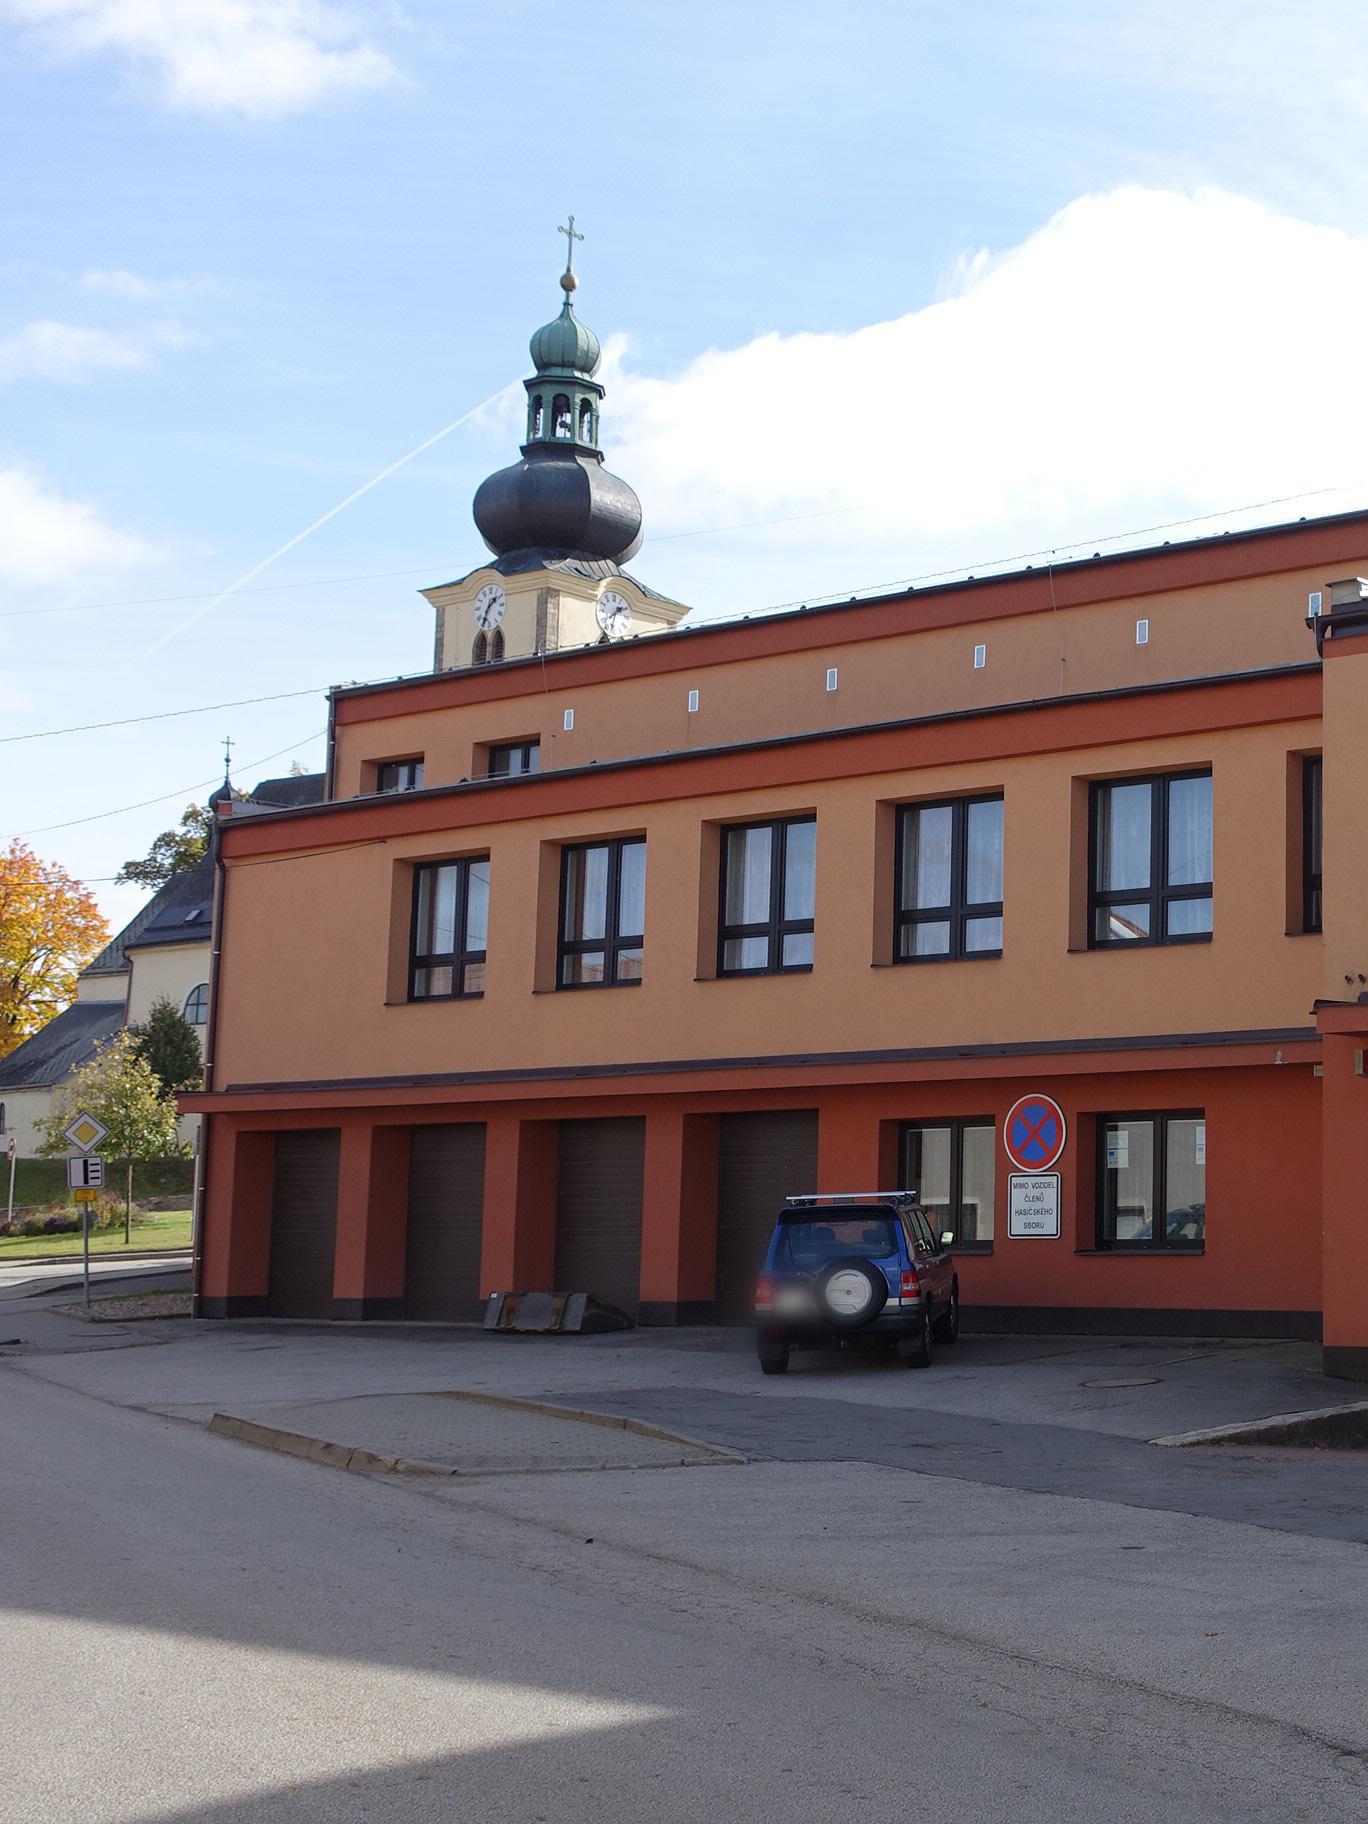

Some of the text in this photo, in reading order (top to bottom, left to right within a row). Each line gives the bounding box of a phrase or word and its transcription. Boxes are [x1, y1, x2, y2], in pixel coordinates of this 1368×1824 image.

[1031, 1181, 1055, 1189] VOZIDEL
[1024, 1193, 1044, 1203] ČLENŮ
[1023, 1221, 1045, 1230] SBORU
